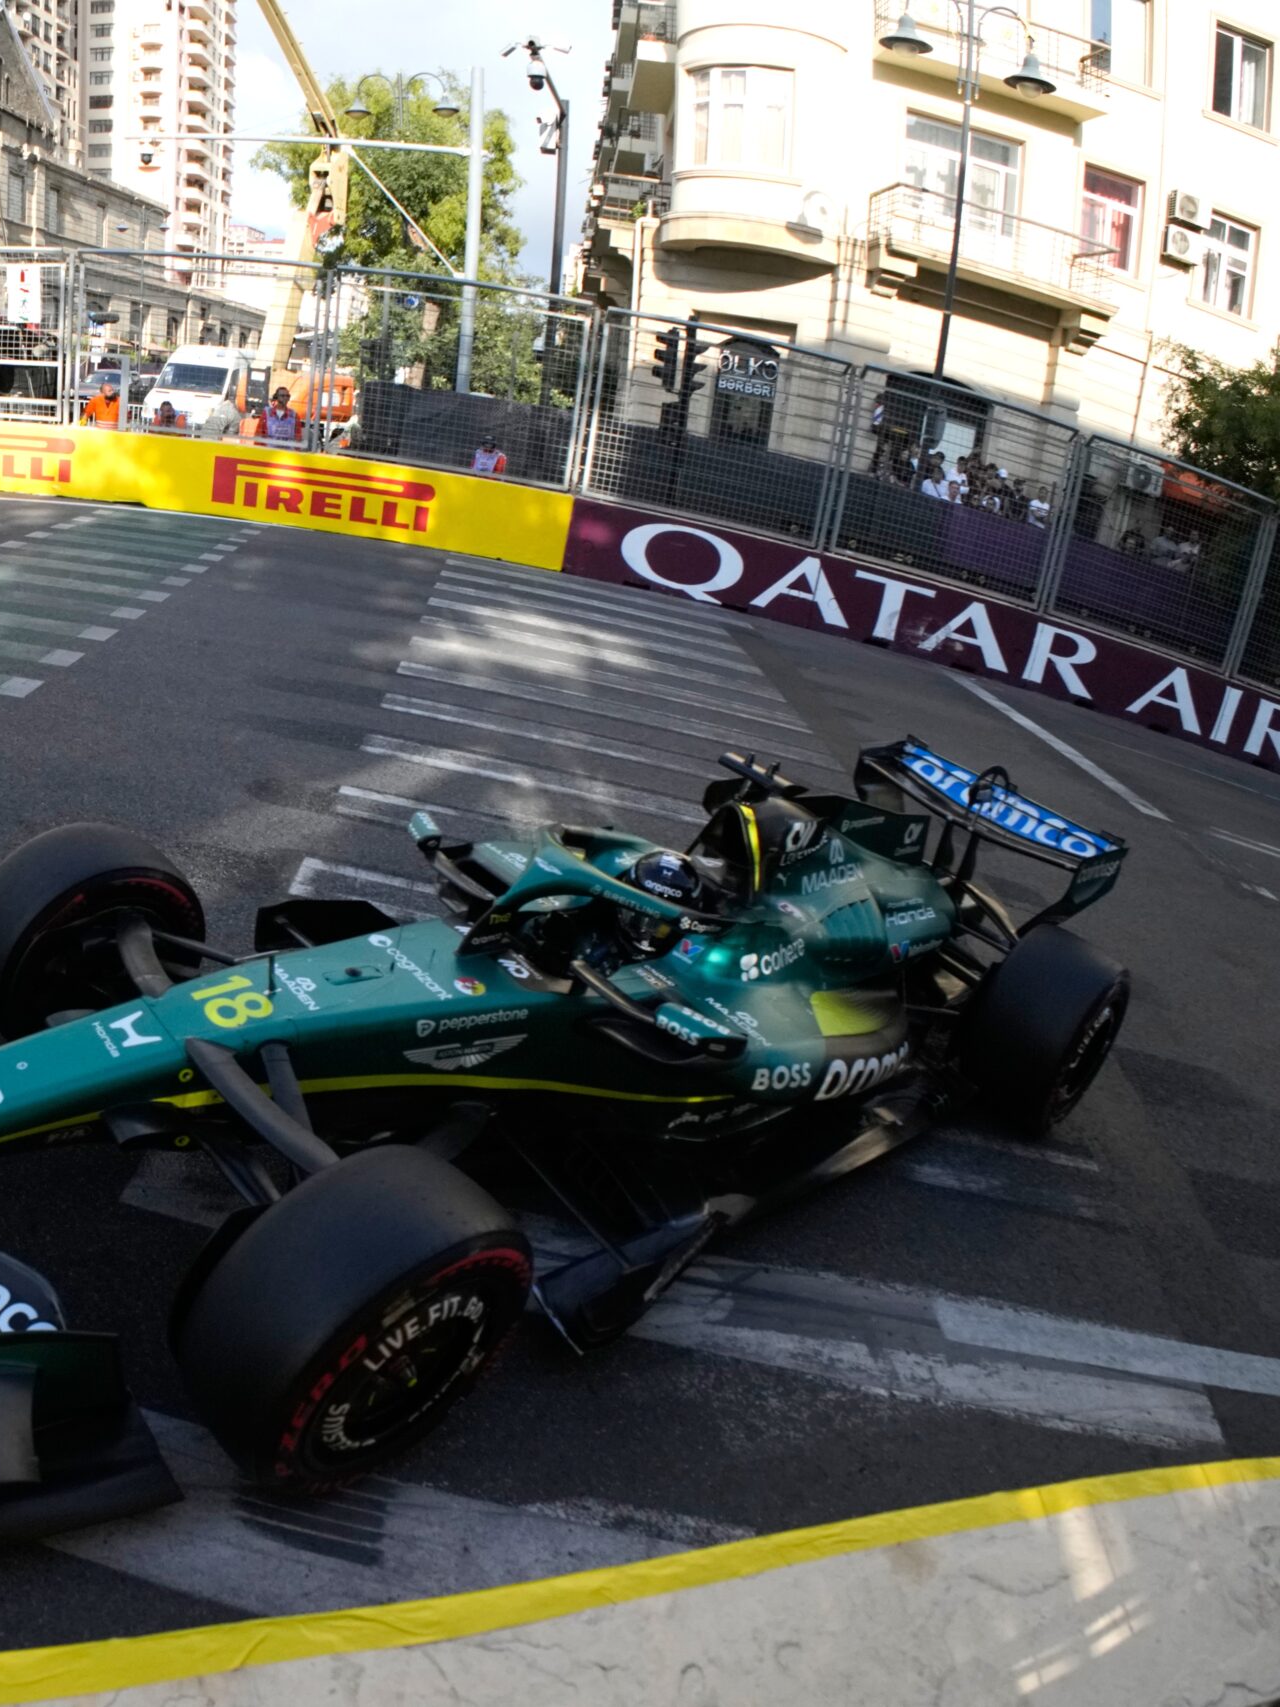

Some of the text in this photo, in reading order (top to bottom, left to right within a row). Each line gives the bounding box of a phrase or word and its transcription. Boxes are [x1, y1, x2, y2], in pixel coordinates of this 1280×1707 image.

[211, 455, 436, 533] PIRELLI
[621, 522, 1097, 701] QATAR
[801, 862, 865, 895] MAADEN
[885, 906, 937, 928] Honda
[386, 946, 453, 1001] cognizant
[760, 938, 805, 976] cohere
[191, 975, 273, 1029] 18
[91, 1021, 121, 1058] Honda
[436, 1008, 529, 1034] pepperstone
[655, 1013, 701, 1046] BOSS
[750, 1061, 812, 1091] BOSS
